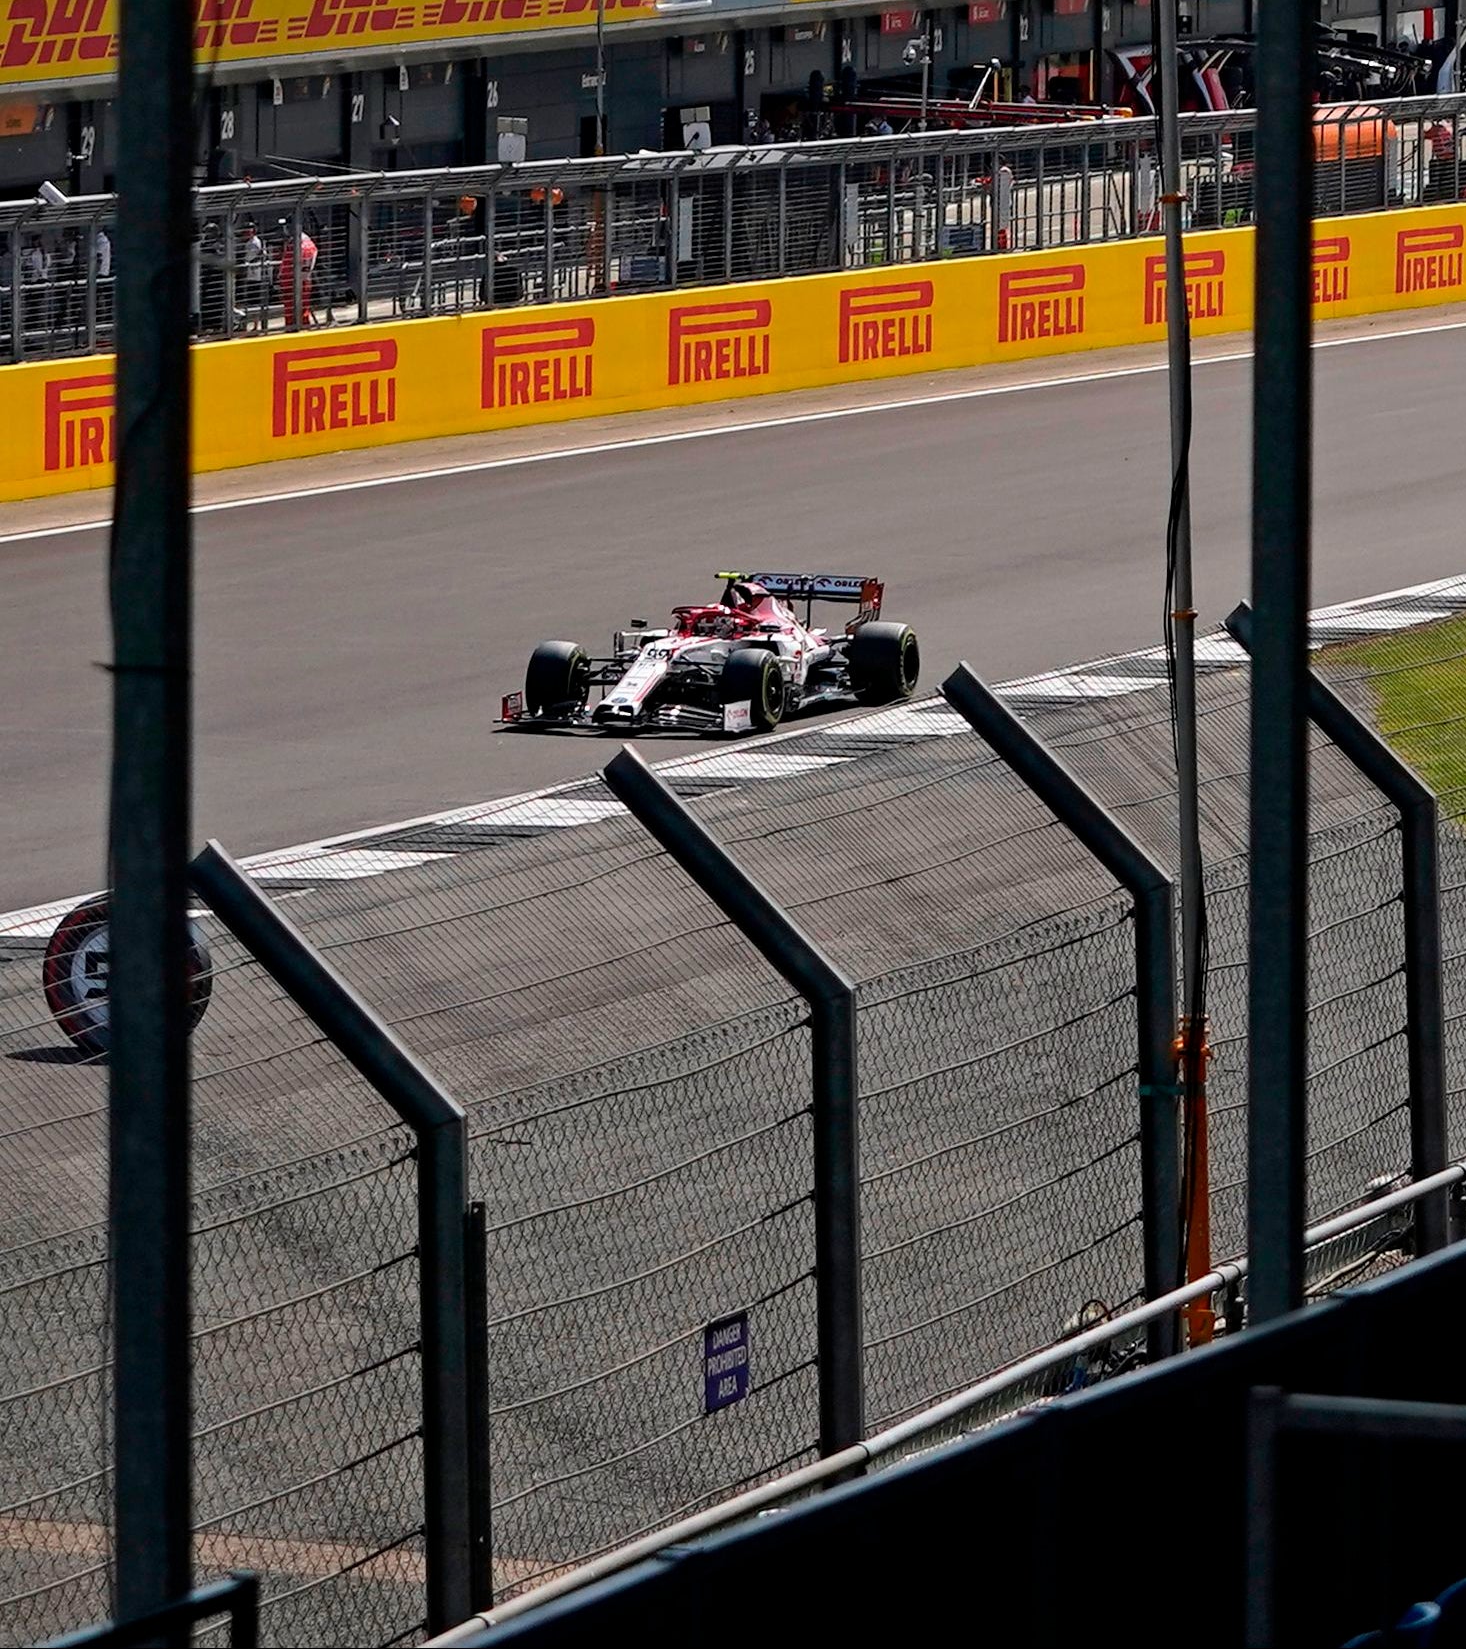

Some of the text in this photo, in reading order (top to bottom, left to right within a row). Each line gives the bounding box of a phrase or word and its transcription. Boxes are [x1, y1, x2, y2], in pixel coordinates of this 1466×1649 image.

[352, 94, 365, 123] 27
[487, 80, 498, 108] 26
[81, 126, 95, 165] 29
[221, 110, 235, 140] 28
[1143, 249, 1225, 325] PIELLI
[1395, 224, 1464, 295] PIRELLI
[838, 280, 934, 364] PIRELLI
[997, 264, 1086, 344] PIRELLI
[480, 317, 595, 410] PIRELLI
[667, 299, 772, 388] PIRELLI
[271, 338, 398, 439] PIRELLI
[708, 1345, 747, 1378] PROHIBITED
[713, 1322, 742, 1350] DANGER
[718, 1374, 738, 1400] AREA
